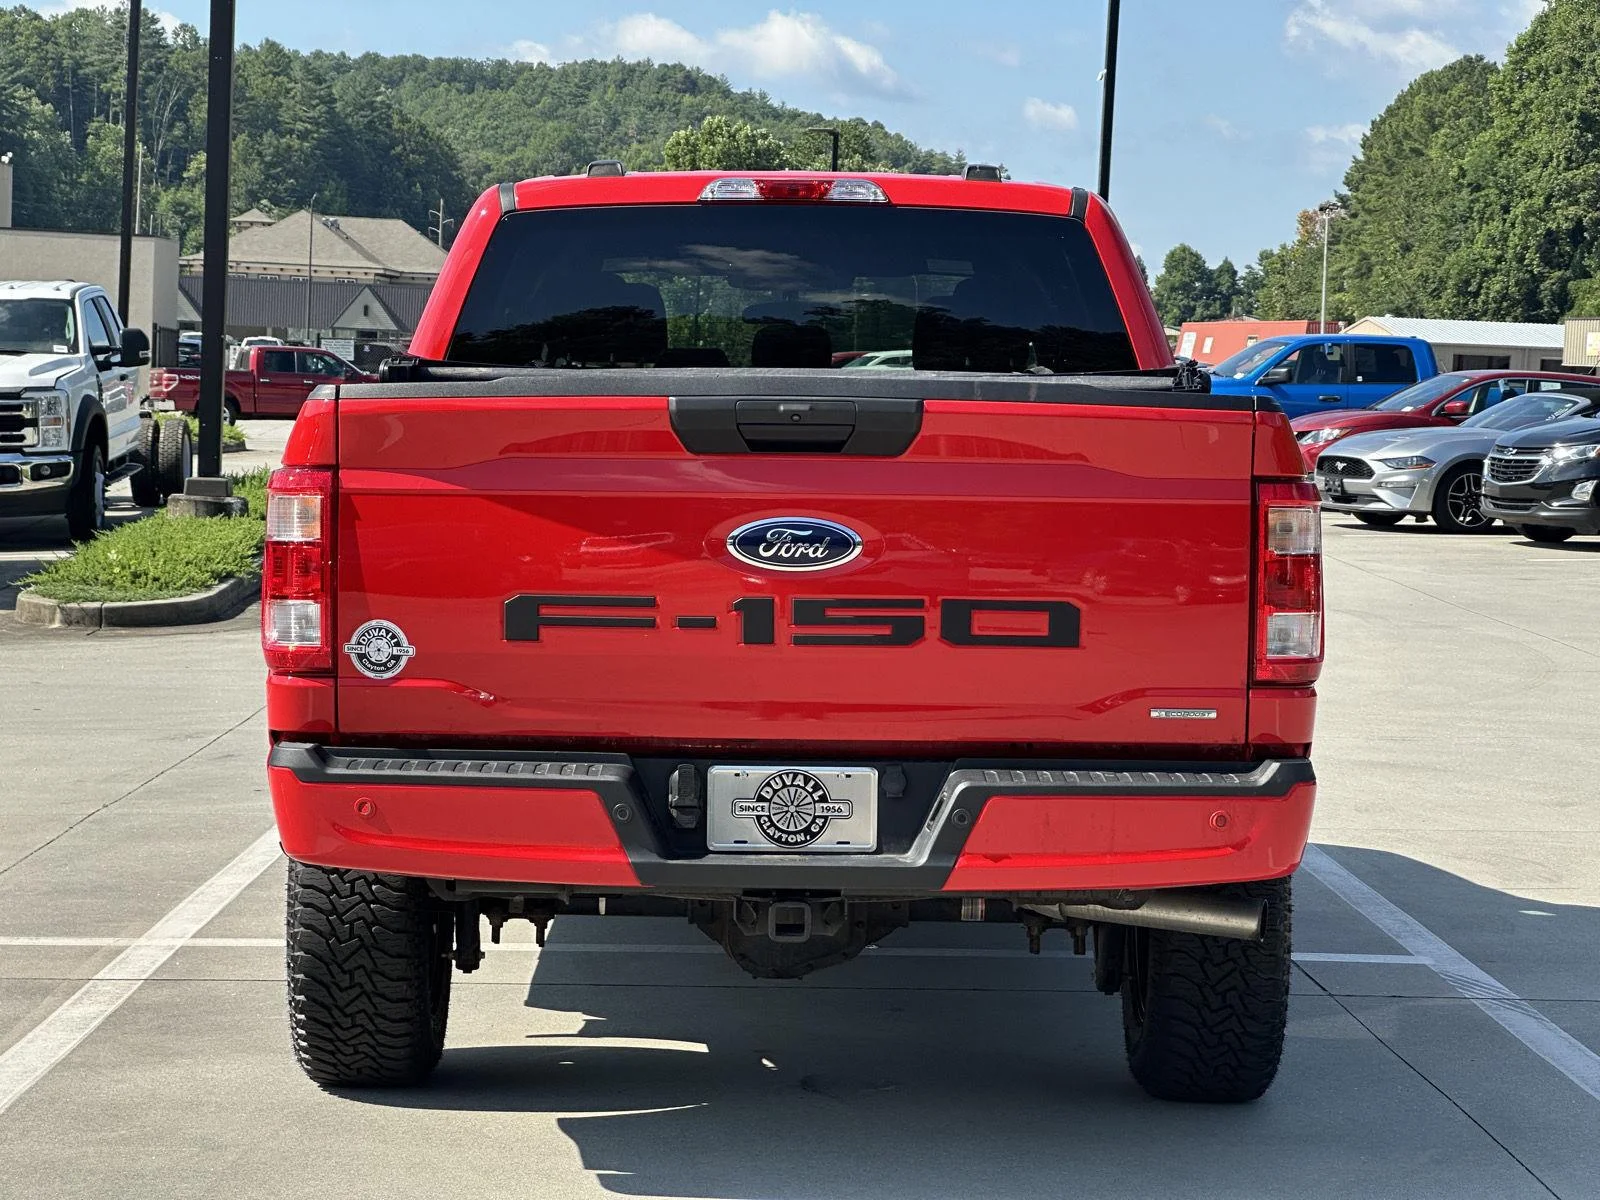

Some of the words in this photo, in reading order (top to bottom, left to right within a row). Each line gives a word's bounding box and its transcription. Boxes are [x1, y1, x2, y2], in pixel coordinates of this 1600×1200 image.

[758, 528, 831, 558] Ford
[504, 594, 1081, 648] F-150
[359, 628, 398, 646] DUVALL
[386, 659, 397, 668] GA
[760, 773, 824, 801] DUVALL
[738, 804, 766, 813] SINCE
[820, 805, 843, 814] 1956
[760, 816, 811, 843] CLAYTON,
[811, 817, 825, 832] GA
